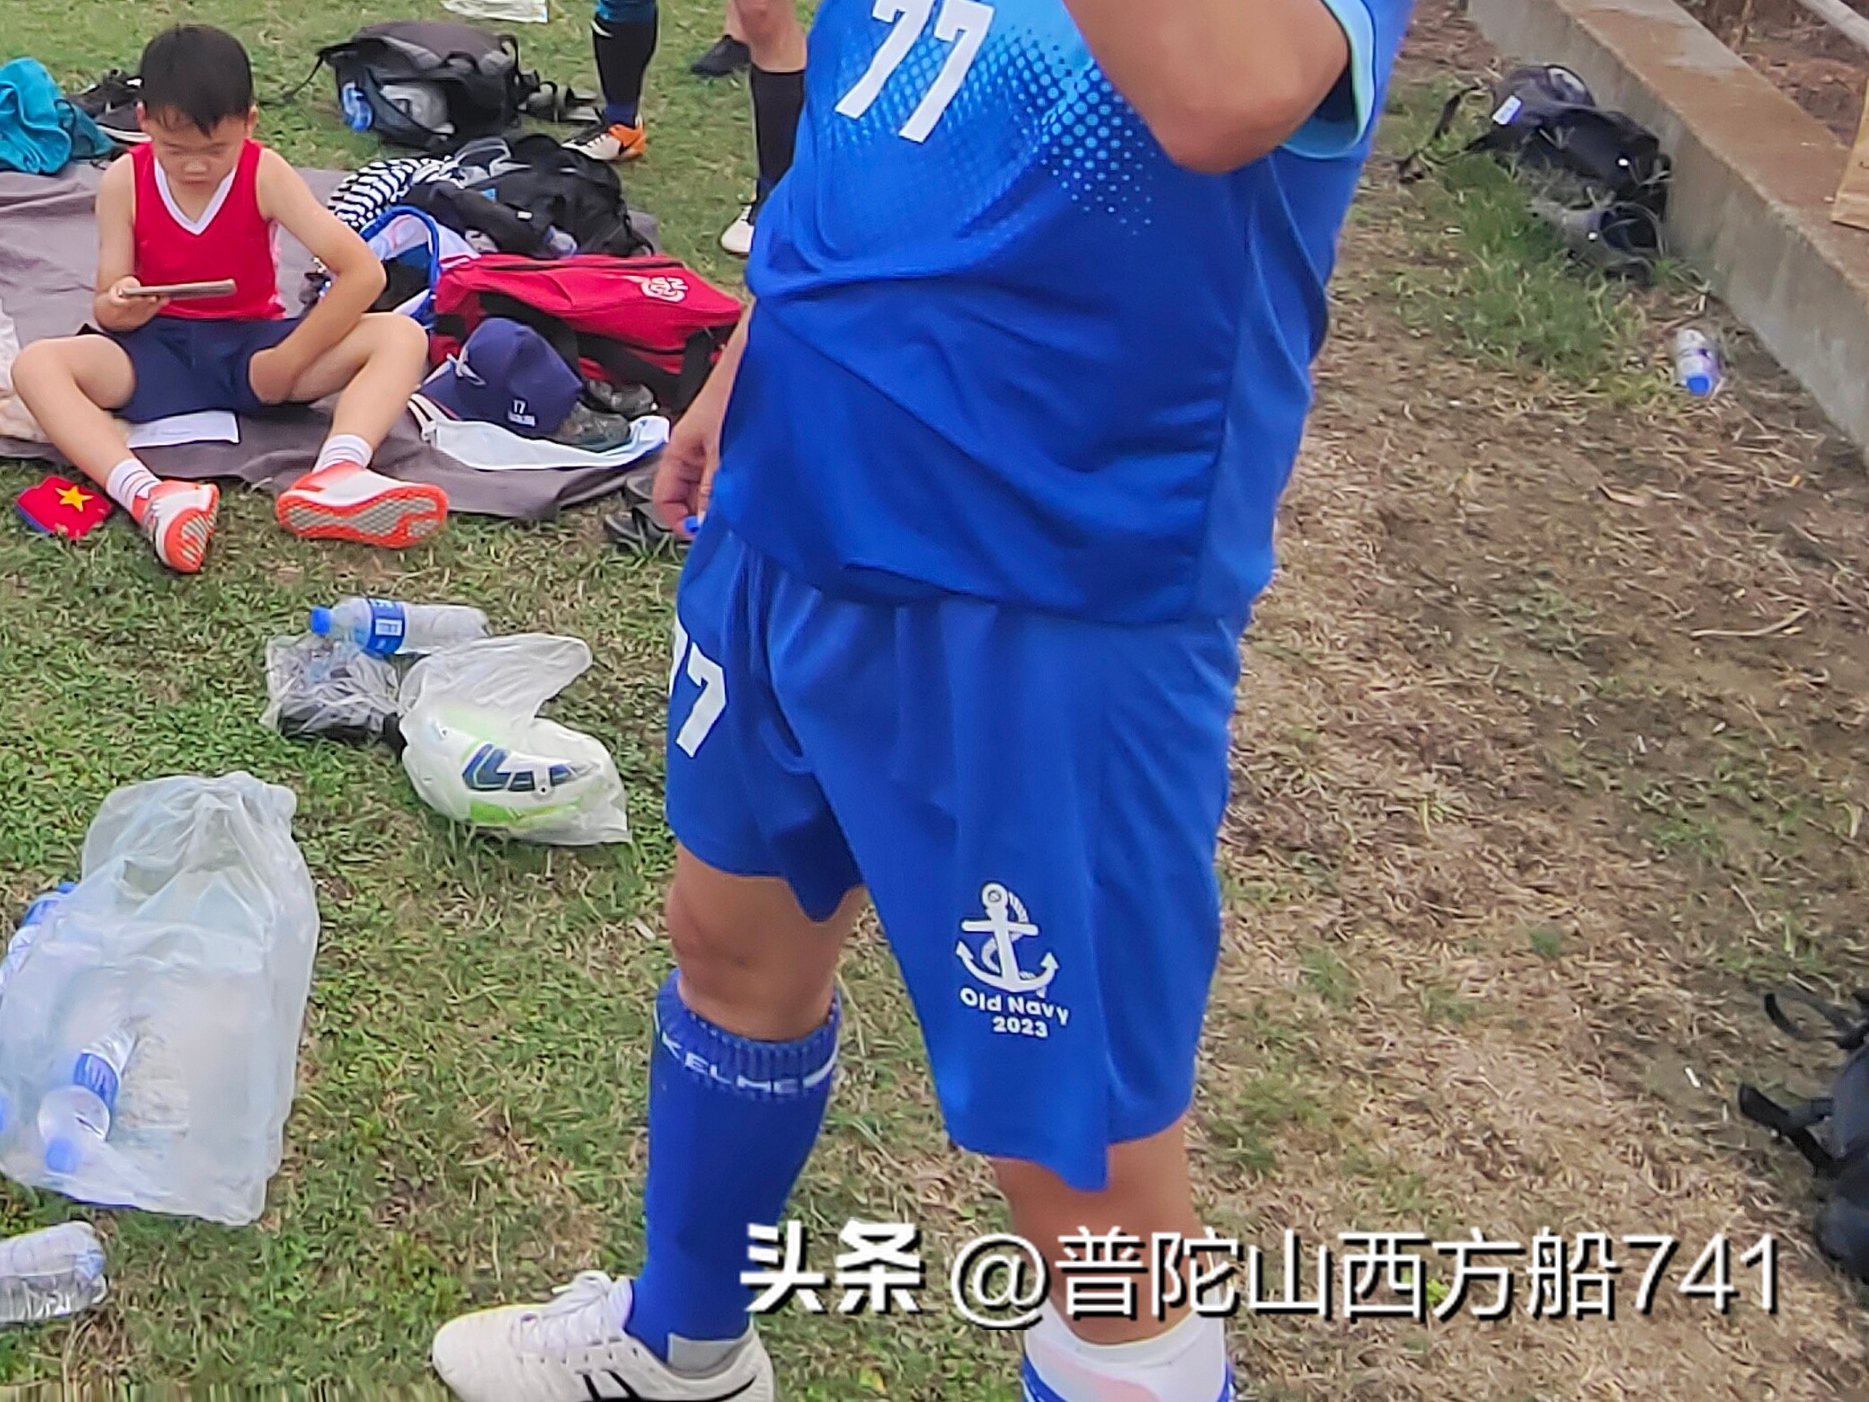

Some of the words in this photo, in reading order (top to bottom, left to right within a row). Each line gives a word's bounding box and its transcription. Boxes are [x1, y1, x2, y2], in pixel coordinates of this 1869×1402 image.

[959, 986, 1003, 1013] Old
[1006, 996, 1070, 1027] Navy
[991, 1015, 1049, 1039] 2023
